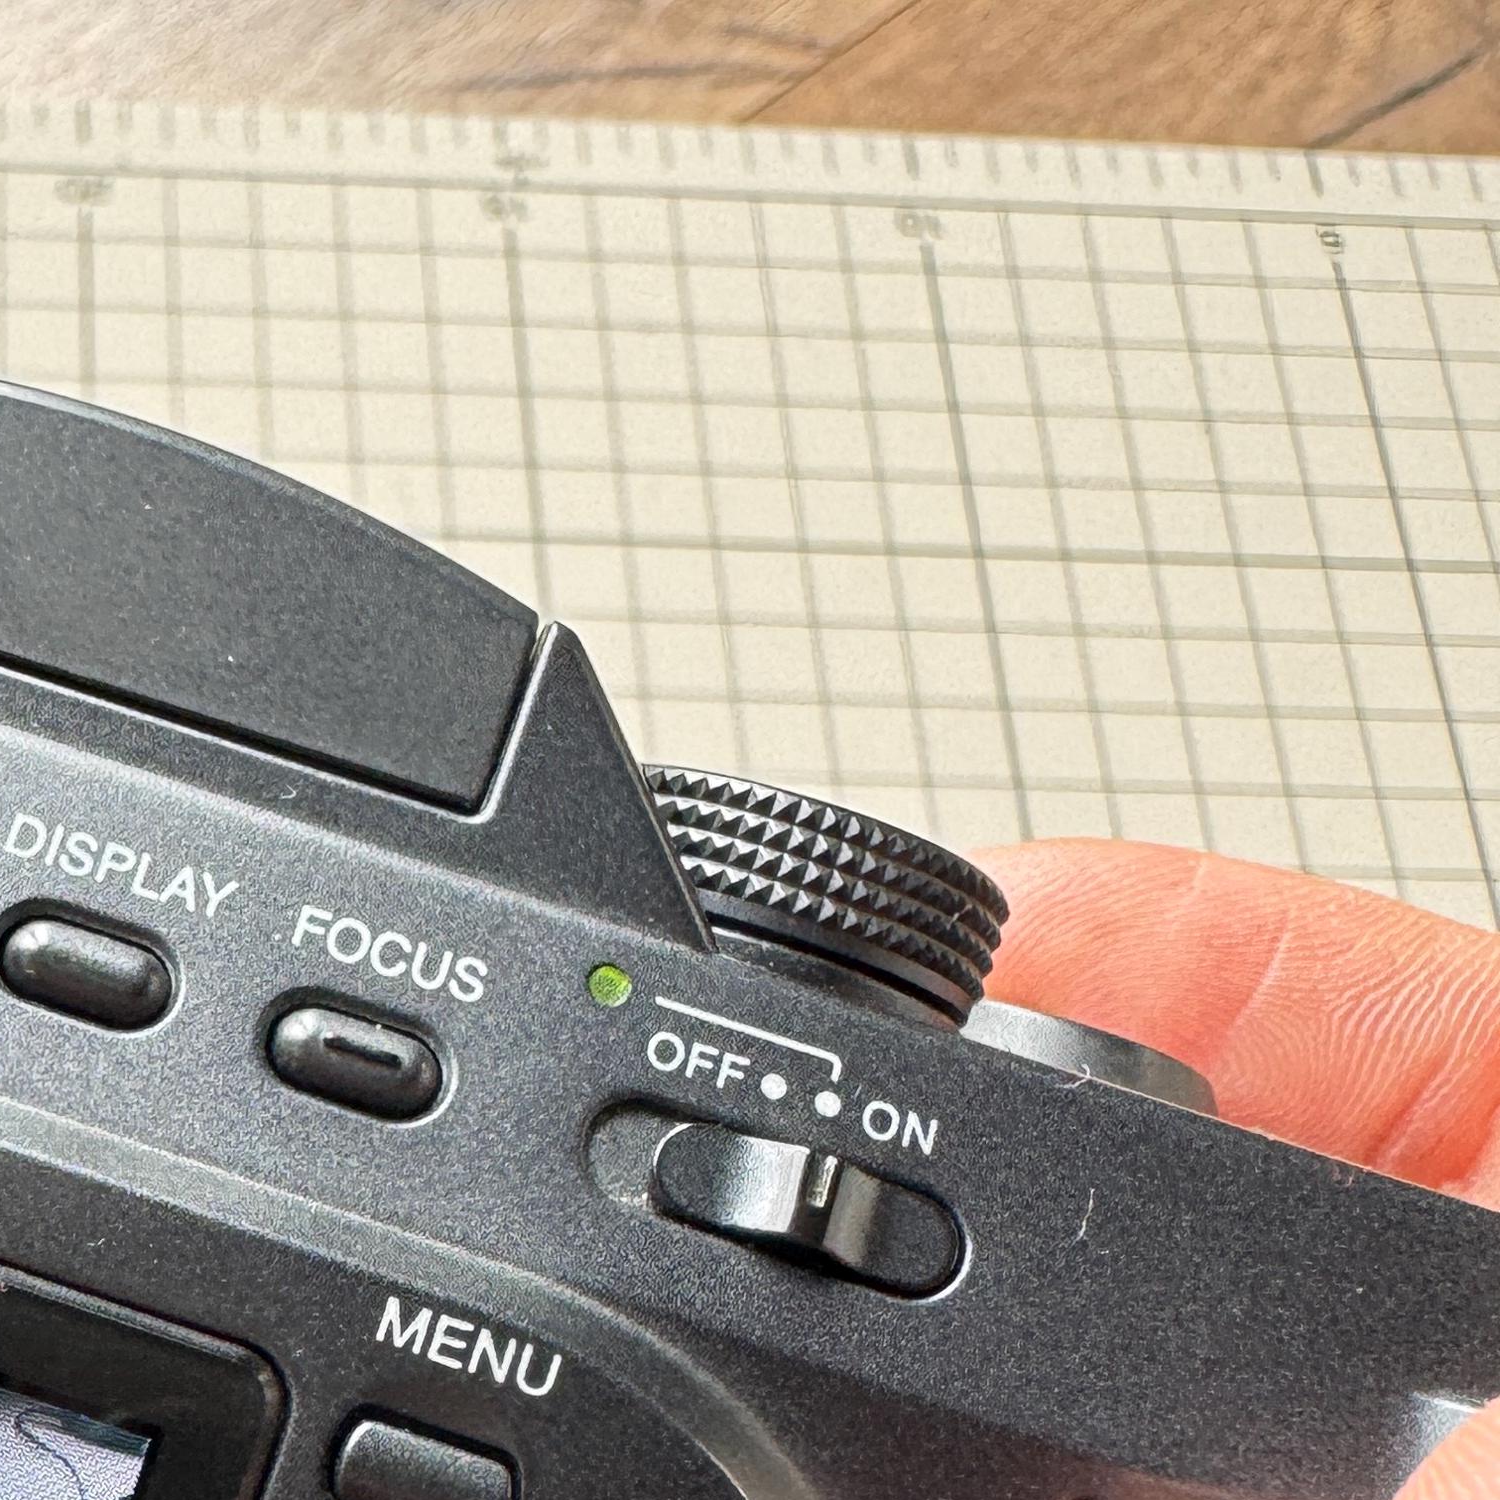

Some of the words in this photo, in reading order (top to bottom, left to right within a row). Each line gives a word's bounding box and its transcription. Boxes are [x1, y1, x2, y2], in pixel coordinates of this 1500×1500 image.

[3, 812, 238, 917] DISPLAY
[290, 906, 489, 1003] FOCUS
[647, 1031, 751, 1089] OFF
[863, 1101, 938, 1156] ON
[375, 1297, 562, 1398] MENU
